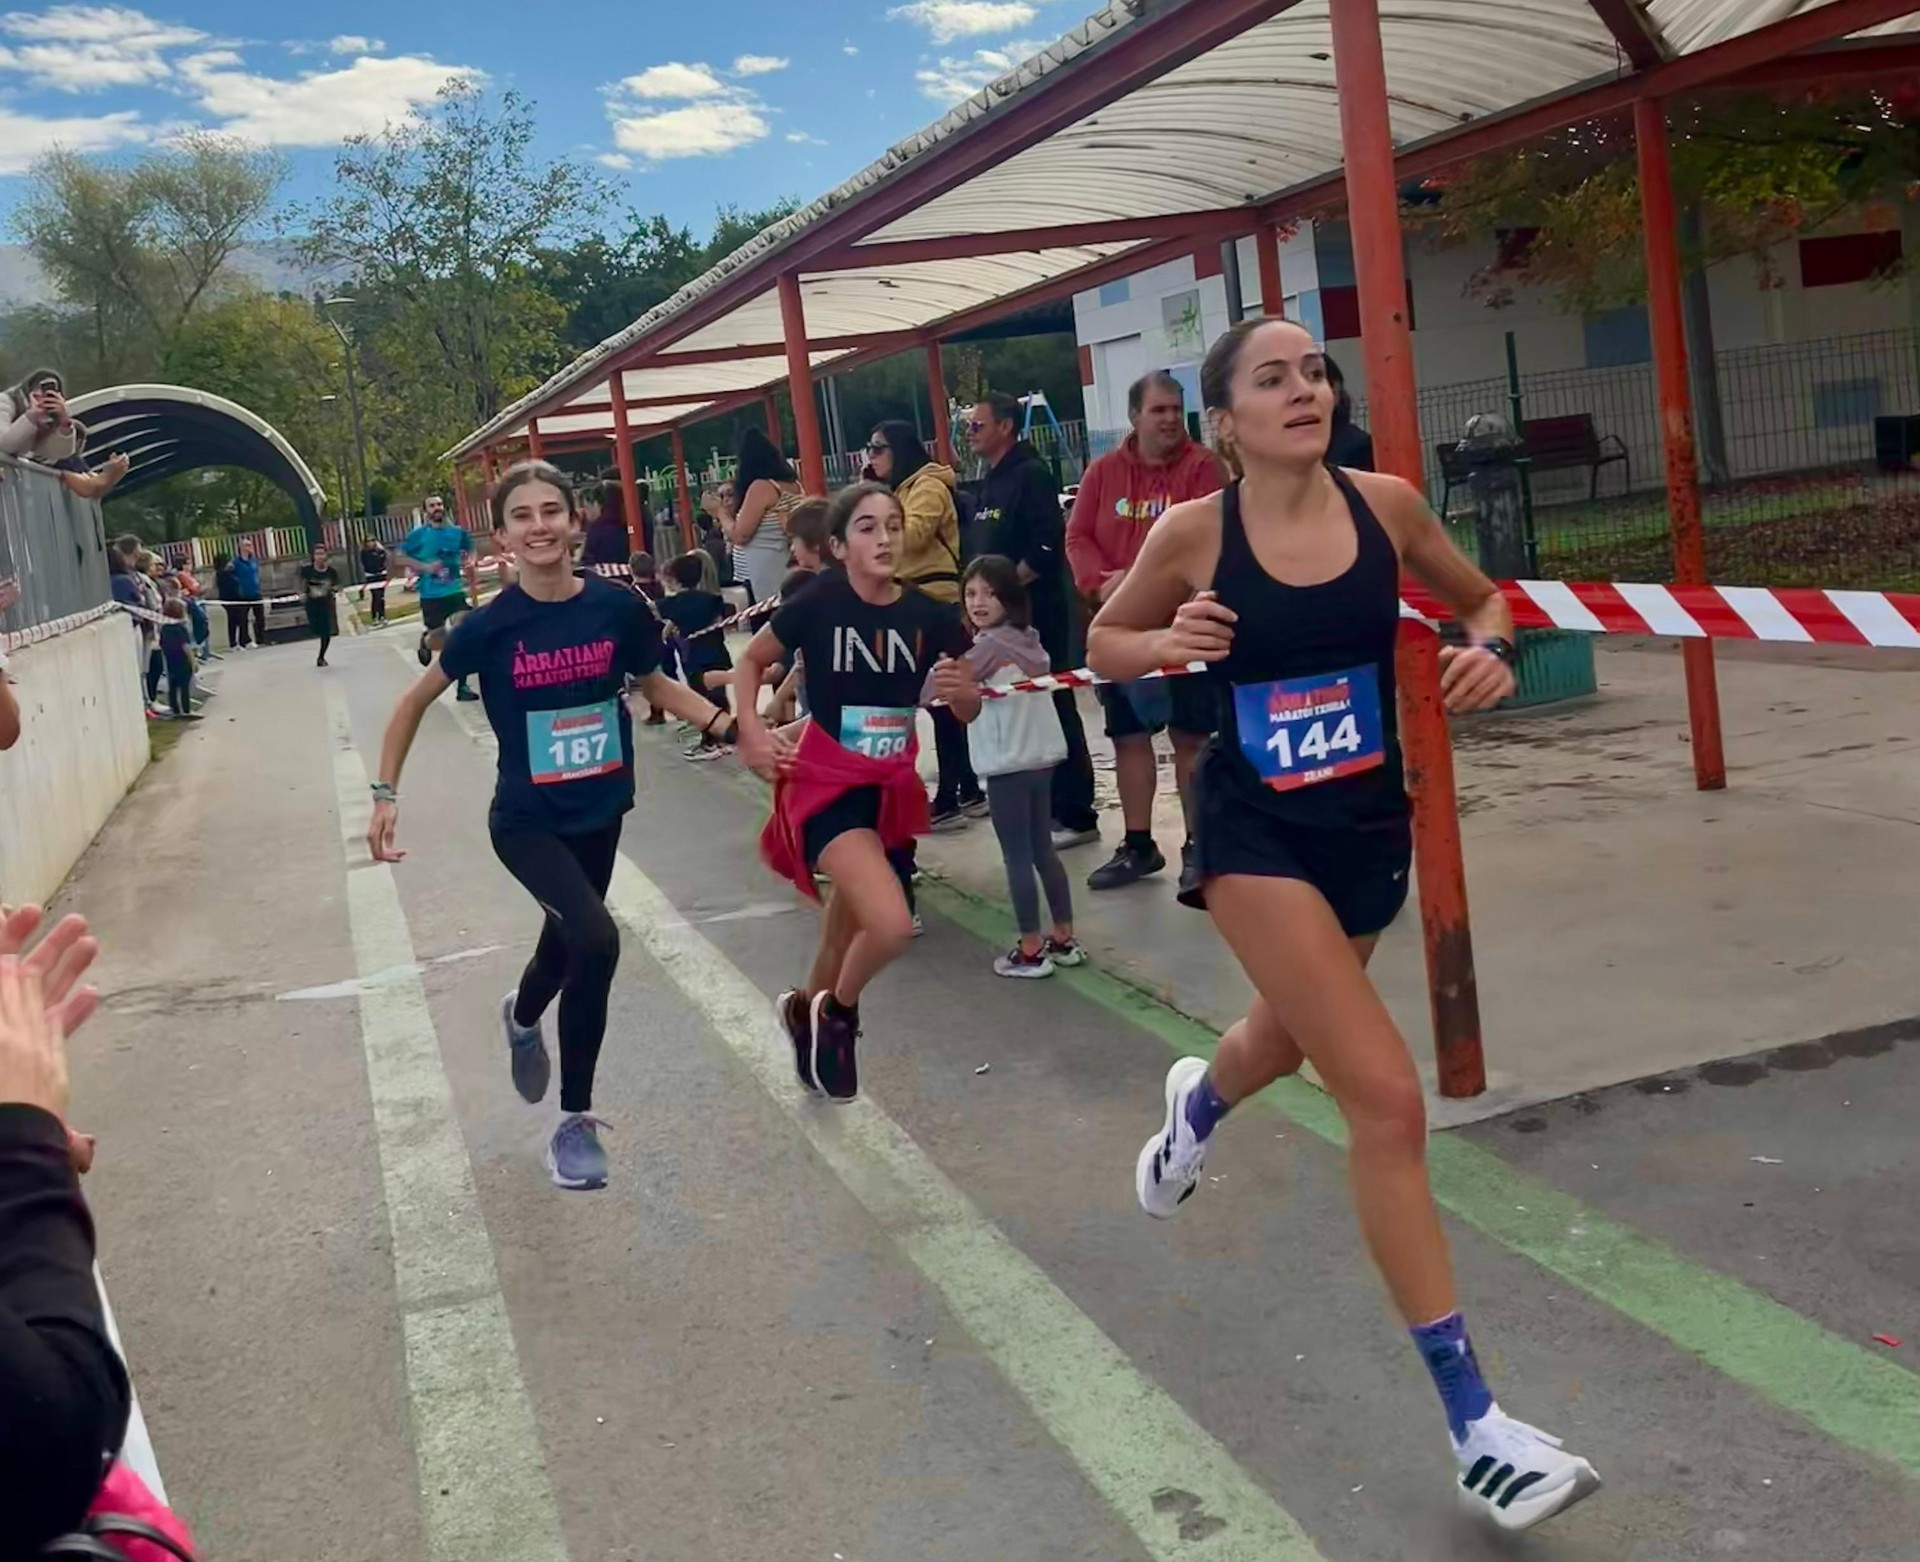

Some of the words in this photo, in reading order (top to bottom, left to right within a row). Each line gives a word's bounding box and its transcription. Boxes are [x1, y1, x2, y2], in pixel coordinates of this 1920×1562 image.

[832, 625, 923, 674] INN
[548, 732, 609, 767] 187
[1266, 713, 1362, 769] 144
